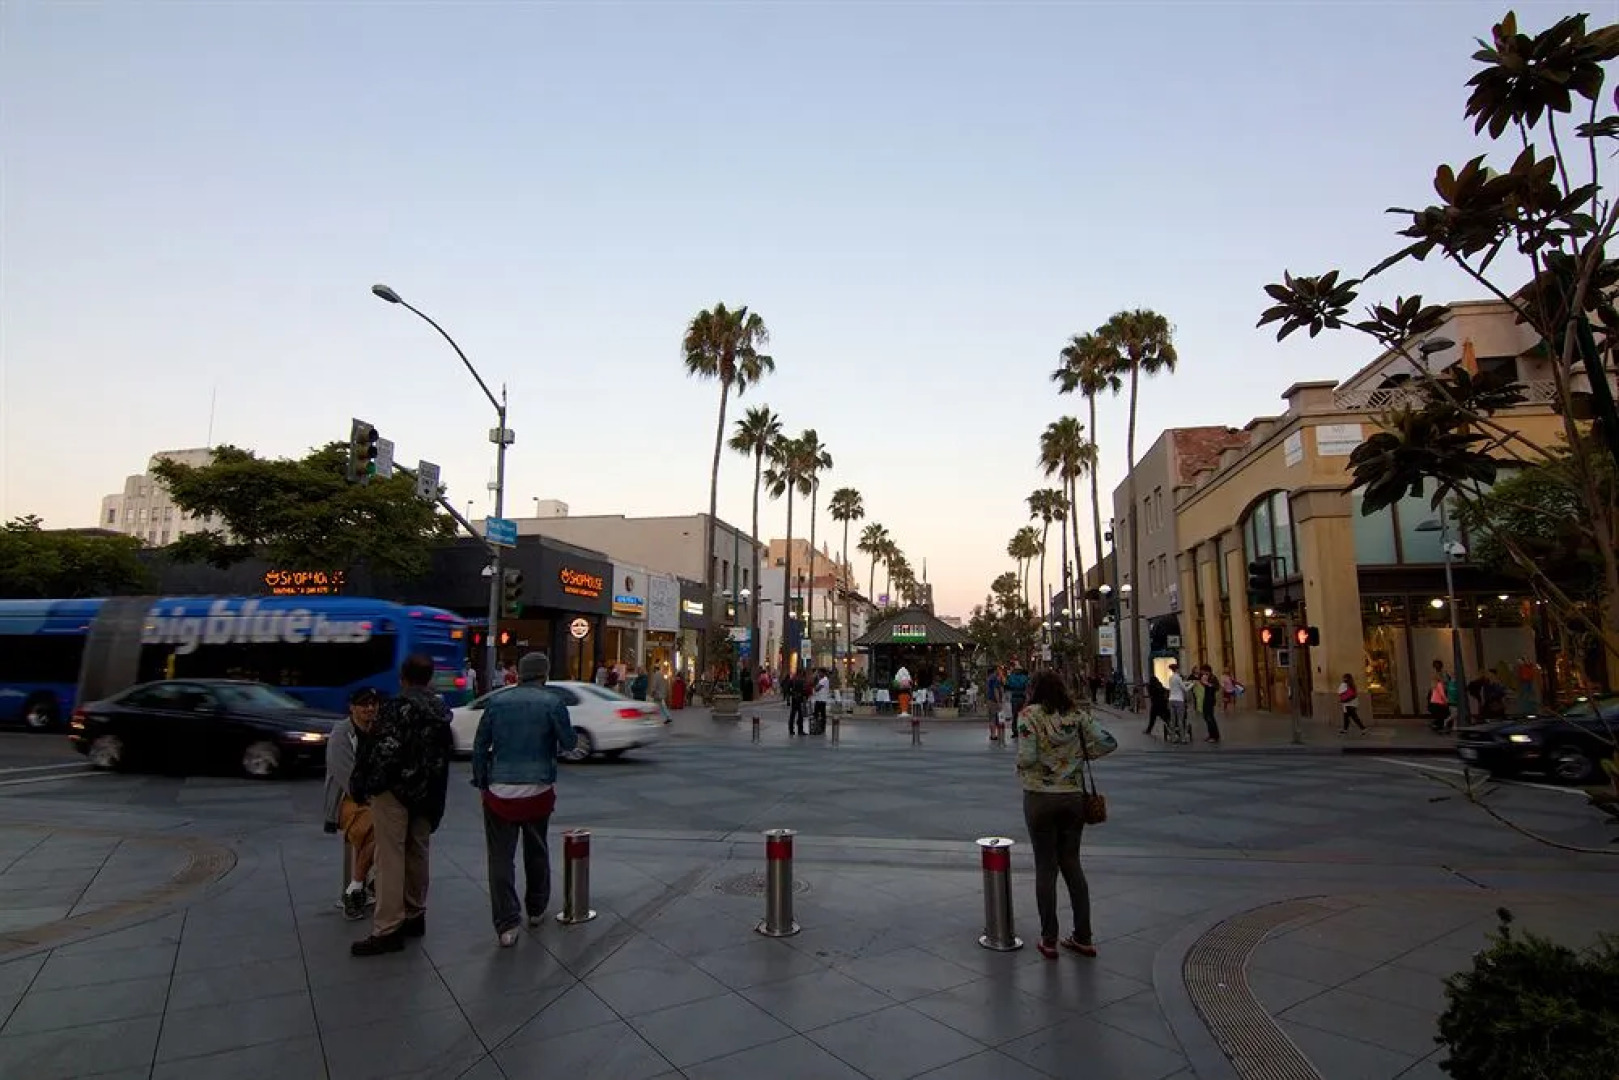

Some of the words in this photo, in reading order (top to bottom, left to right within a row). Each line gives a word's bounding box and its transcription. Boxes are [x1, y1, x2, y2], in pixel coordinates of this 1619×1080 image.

[141, 607, 200, 655] big
[203, 600, 312, 643] blue
[310, 612, 372, 643] bus
